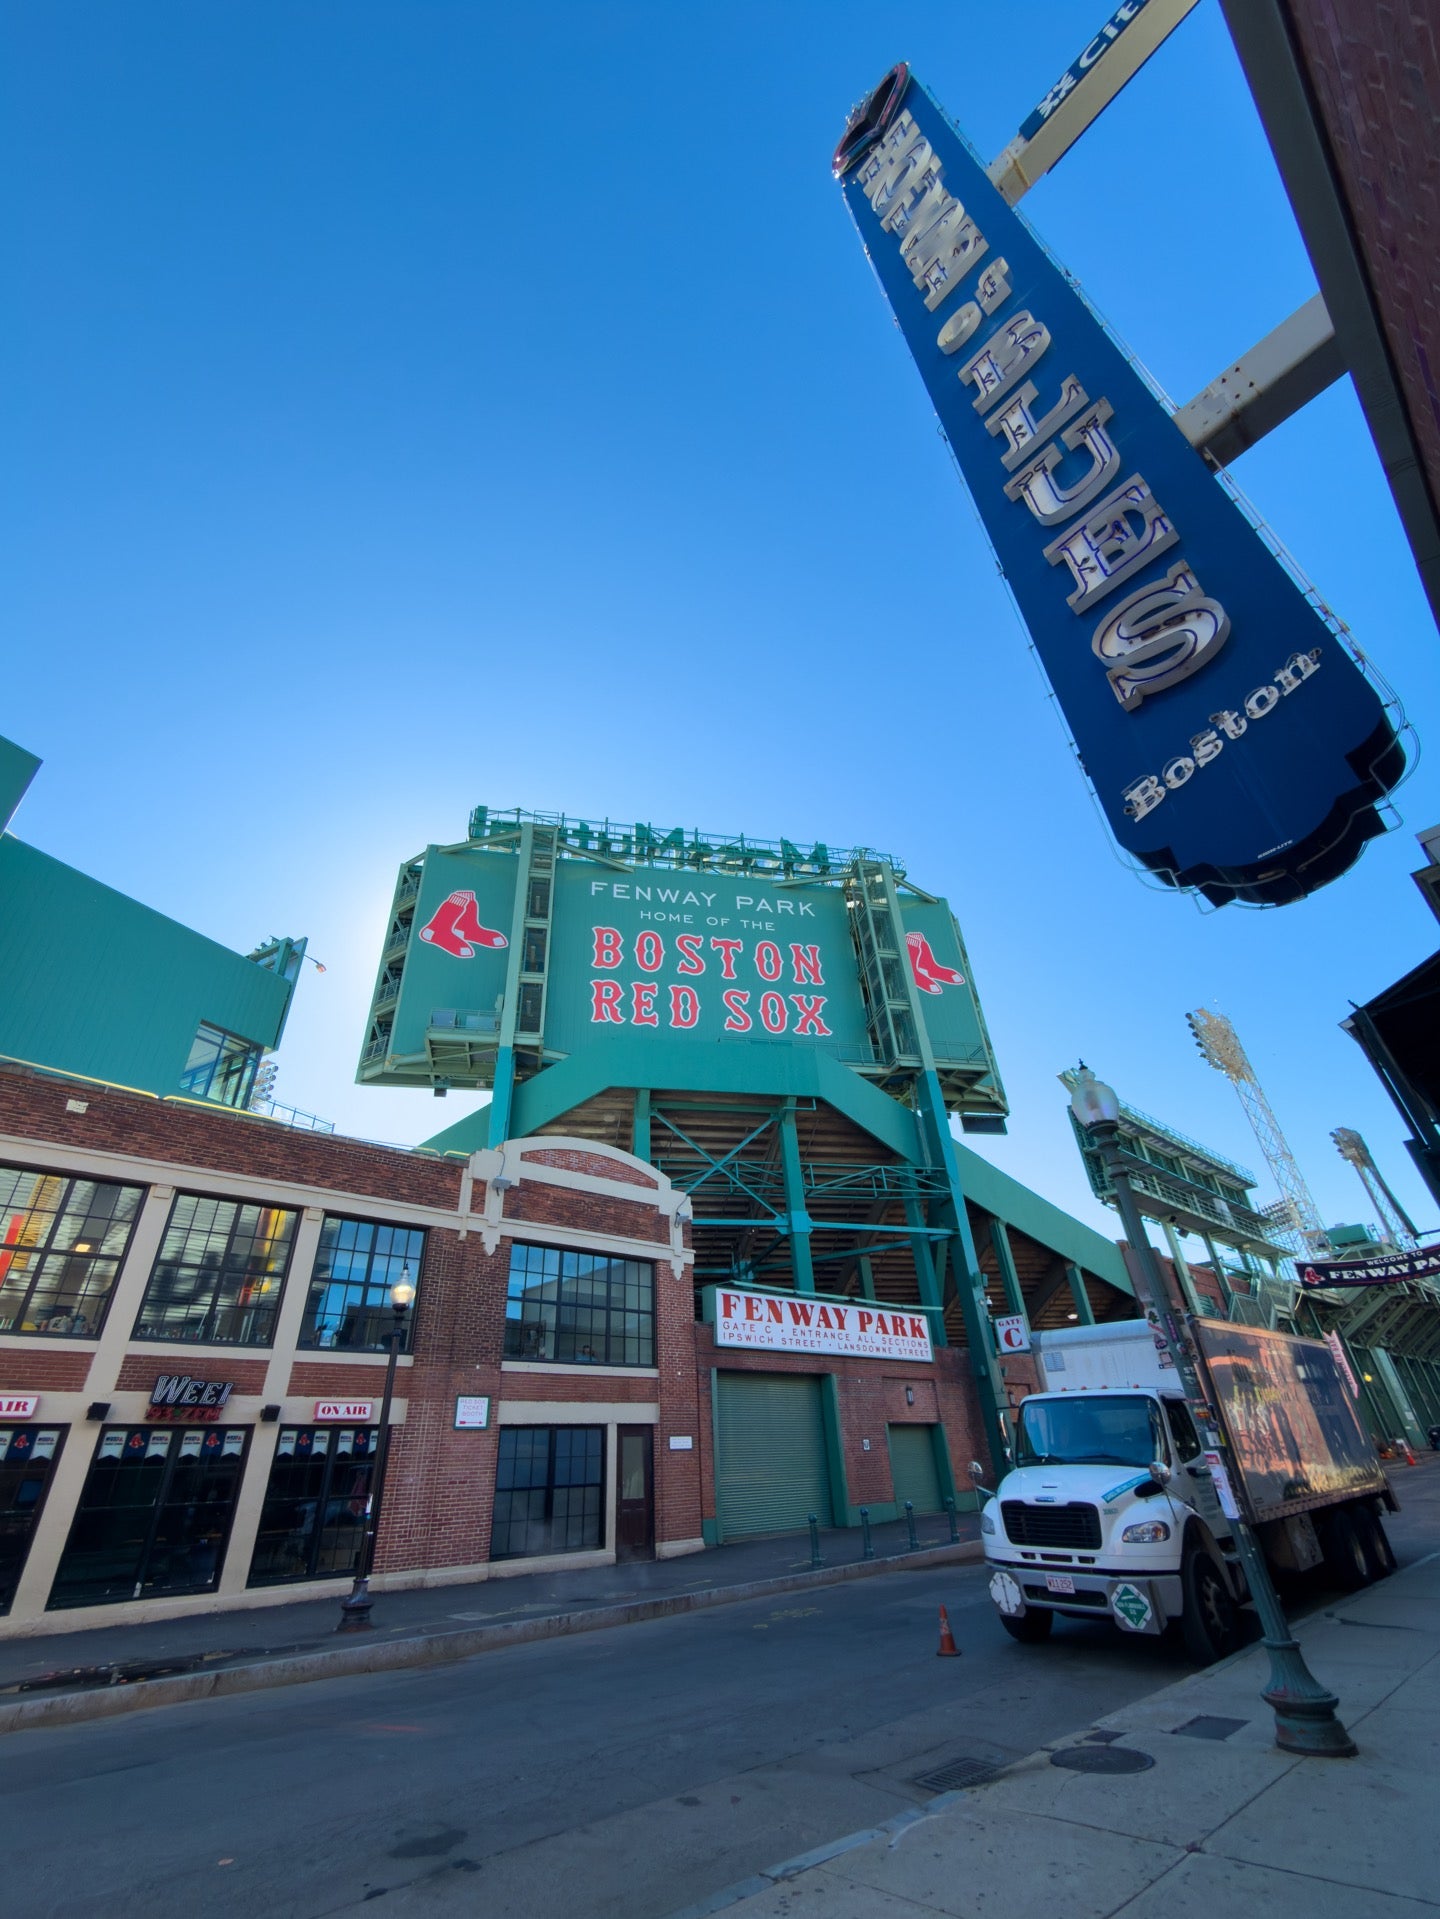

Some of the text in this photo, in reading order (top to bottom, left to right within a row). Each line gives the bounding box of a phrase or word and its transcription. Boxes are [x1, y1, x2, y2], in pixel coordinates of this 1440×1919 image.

[1079, 0, 1145, 68] Cit
[857, 108, 989, 312] HOUSE
[958, 310, 1231, 712] BLUES
[1123, 648, 1321, 823] Boston
[591, 881, 815, 917] FENWAY PARK
[640, 910, 775, 931] HOME OF THE
[591, 926, 826, 985] BOSTON
[590, 979, 832, 1036] RED SOX
[1329, 1263, 1410, 1279] FENWAY
[1413, 1254, 1440, 1270] PA
[1366, 1250, 1423, 1266] WELCOME TO
[721, 1293, 927, 1339] FENWAY PARK
[998, 1318, 1022, 1327] GATE
[723, 1321, 929, 1348] GATE C ENTRANCE ALL SECTIONS
[723, 1332, 930, 1357] IPSWICH STREET LANSDOWNE STREET
[1004, 1328, 1023, 1347] C
[152, 1375, 234, 1404] WEEI
[0, 1401, 29, 1412] IR
[321, 1406, 367, 1415] ON AIR
